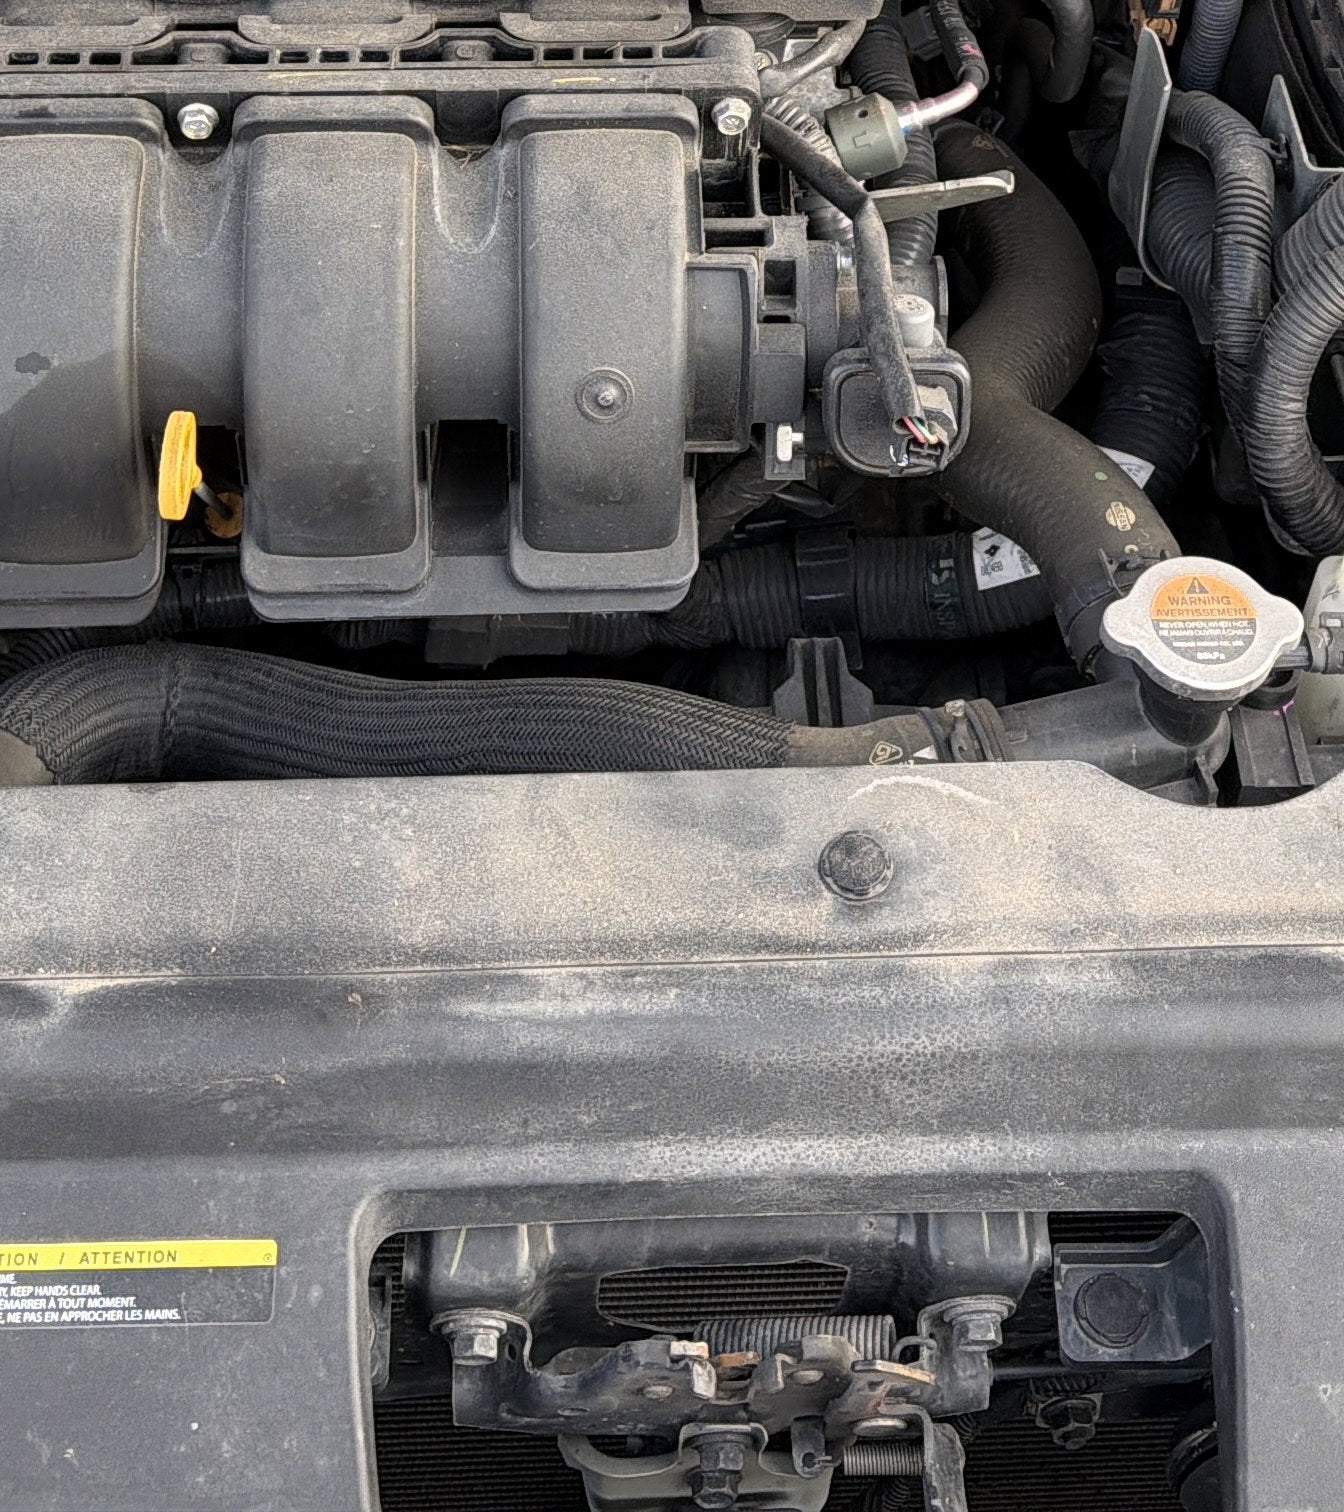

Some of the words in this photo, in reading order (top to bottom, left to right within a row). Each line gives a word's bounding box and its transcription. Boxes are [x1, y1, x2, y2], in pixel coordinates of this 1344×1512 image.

[1167, 596, 1231, 606] WARNING
[1156, 608, 1248, 617] AVERTISSEMENT
[59, 1252, 65, 1265] /
[79, 1250, 177, 1264] ATTENTION
[10, 1287, 34, 1297] KEEP
[35, 1286, 69, 1296] HANDS
[70, 1285, 101, 1296] CLEAR.
[58, 1298, 86, 1308] TOUT
[87, 1297, 136, 1308] MOMENT.
[7, 1312, 26, 1323] NE
[23, 1312, 42, 1322] PAS
[45, 1311, 59, 1322] EN
[60, 1310, 123, 1321] APPROCHER
[125, 1310, 143, 1320] LES
[145, 1309, 181, 1320] MAINS.
